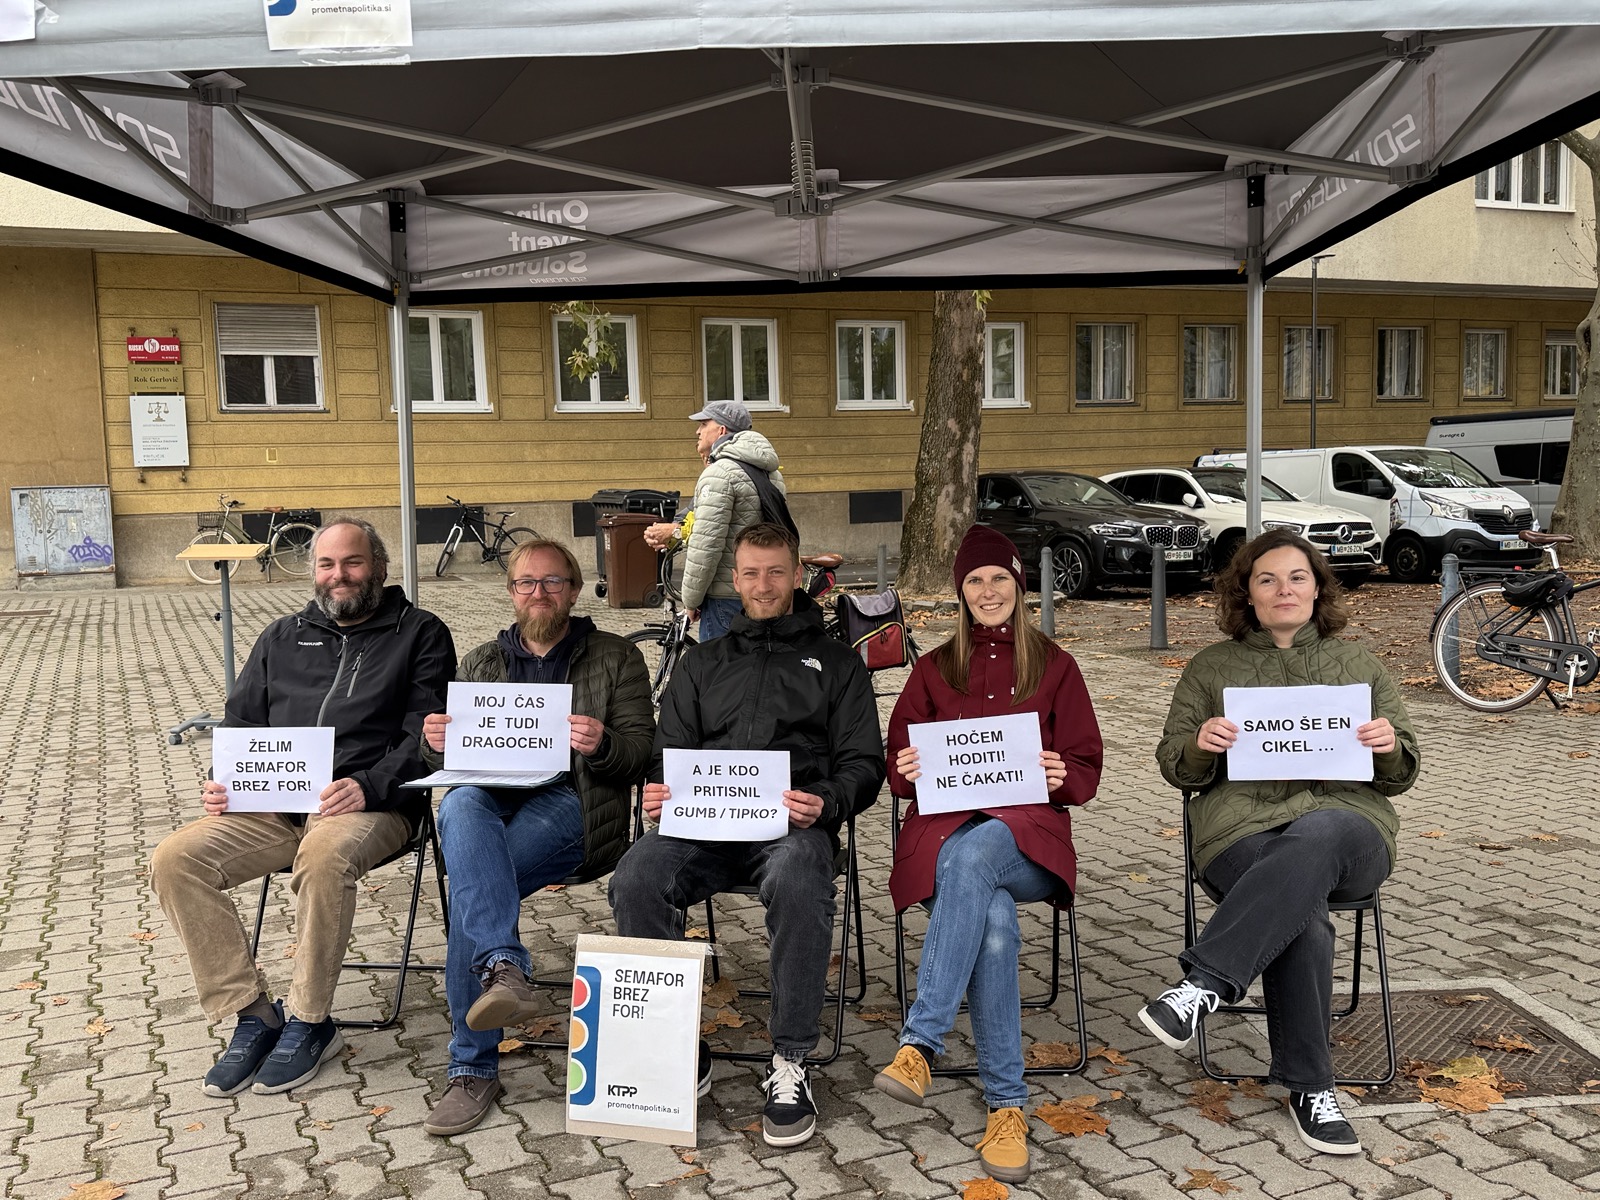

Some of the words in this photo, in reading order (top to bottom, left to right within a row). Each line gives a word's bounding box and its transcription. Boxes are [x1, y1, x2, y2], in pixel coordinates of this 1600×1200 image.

[311, 4, 392, 15] prometnapolitika.si
[160, 344, 180, 352] CENTER
[474, 695, 506, 708] MOJ
[514, 694, 545, 709] ČAS
[478, 716, 496, 729] JE
[504, 717, 539, 729] TUDI
[1243, 719, 1295, 732] SAMO
[1300, 716, 1322, 731] ŠE
[1327, 717, 1351, 730] EN
[248, 738, 292, 752] ŽELIM
[462, 736, 553, 749] DRAGOCEN!
[946, 730, 1004, 747] HOČEM
[1262, 740, 1313, 753] CIKEL
[949, 750, 1005, 766] HODITI!
[235, 761, 307, 773] SEMAFOR
[692, 764, 702, 776] A
[708, 764, 722, 776] JE
[728, 765, 760, 777] KDO
[232, 780, 270, 792] BREZ
[277, 780, 311, 792] FOR!
[936, 775, 958, 789] NE
[962, 769, 1024, 787] ČAKATI!
[693, 785, 761, 798] PRITISNIL
[614, 969, 684, 988] SEMAFOR
[613, 986, 650, 1003] BREZ
[612, 1003, 645, 1020] FOR!
[607, 1084, 638, 1098] KTPP
[607, 1101, 680, 1115] prometnapolitika.si
